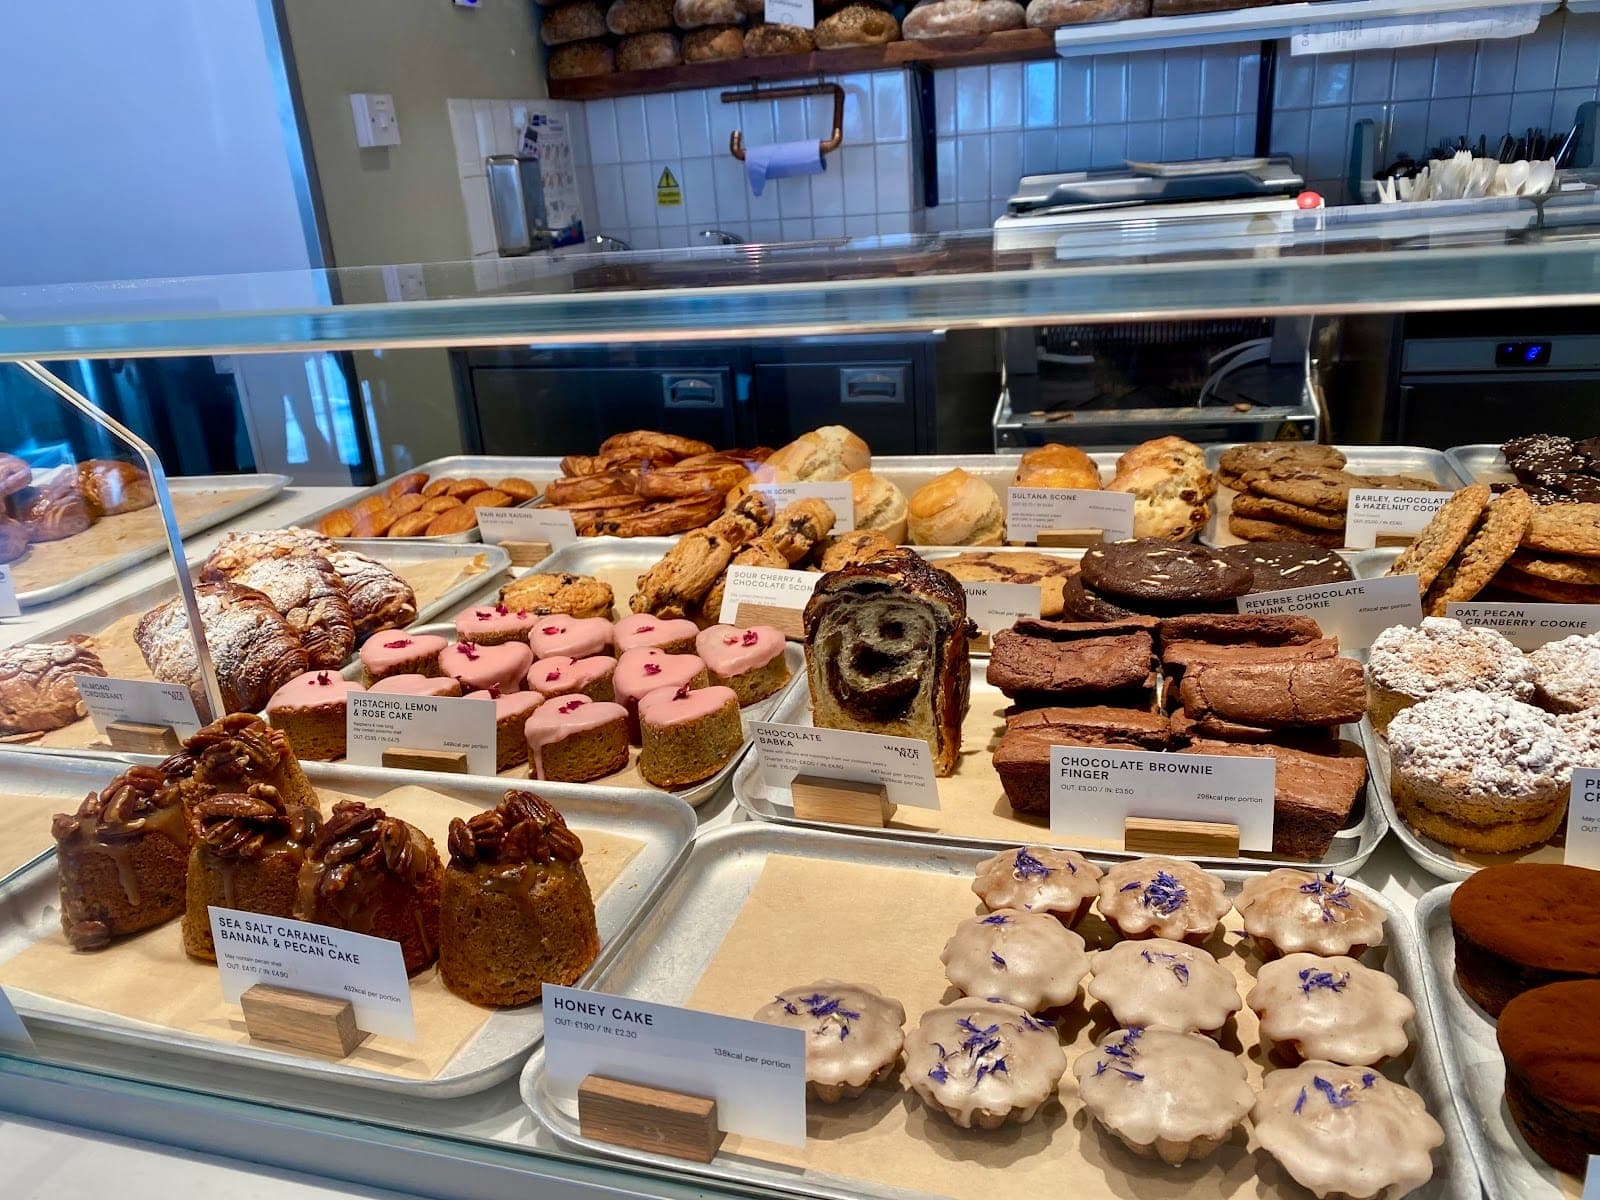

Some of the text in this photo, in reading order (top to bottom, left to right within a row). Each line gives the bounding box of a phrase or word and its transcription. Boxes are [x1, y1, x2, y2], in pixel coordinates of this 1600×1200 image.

[760, 574, 794, 582] CHERRY
[733, 579, 813, 592] CHOCOLATE SCON
[1246, 586, 1365, 609] REVERSE CHOCOLATE
[1288, 600, 1330, 612] COOKIE
[1540, 620, 1588, 628] COOKIE
[82, 682, 110, 691] ALMOND
[85, 690, 123, 700] CROISSANT
[353, 699, 438, 712] PISTACHIO, LEMON
[362, 709, 385, 719] ROSE
[389, 712, 413, 720] CAKE
[757, 728, 822, 742] CHOCOLATE
[760, 738, 794, 748] BABKA
[884, 745, 919, 754] WASTE
[1061, 756, 1213, 774] CHOCOLATE BROWNIE
[1061, 768, 1109, 780] FINGER
[1238, 796, 1263, 804] portion
[219, 917, 338, 947] SEA SALT CARAMEL,
[222, 930, 360, 964] BANANA & PECAN CAKE
[368, 989, 378, 999] per
[379, 992, 401, 1003] portion
[555, 997, 653, 1026] HONEY CAKE
[555, 1017, 573, 1027] OUT:
[574, 1021, 595, 1031] £1.90
[603, 1026, 613, 1035] IN:
[615, 1028, 637, 1039] £2.30
[714, 1047, 791, 1070] 138kcal per portion
